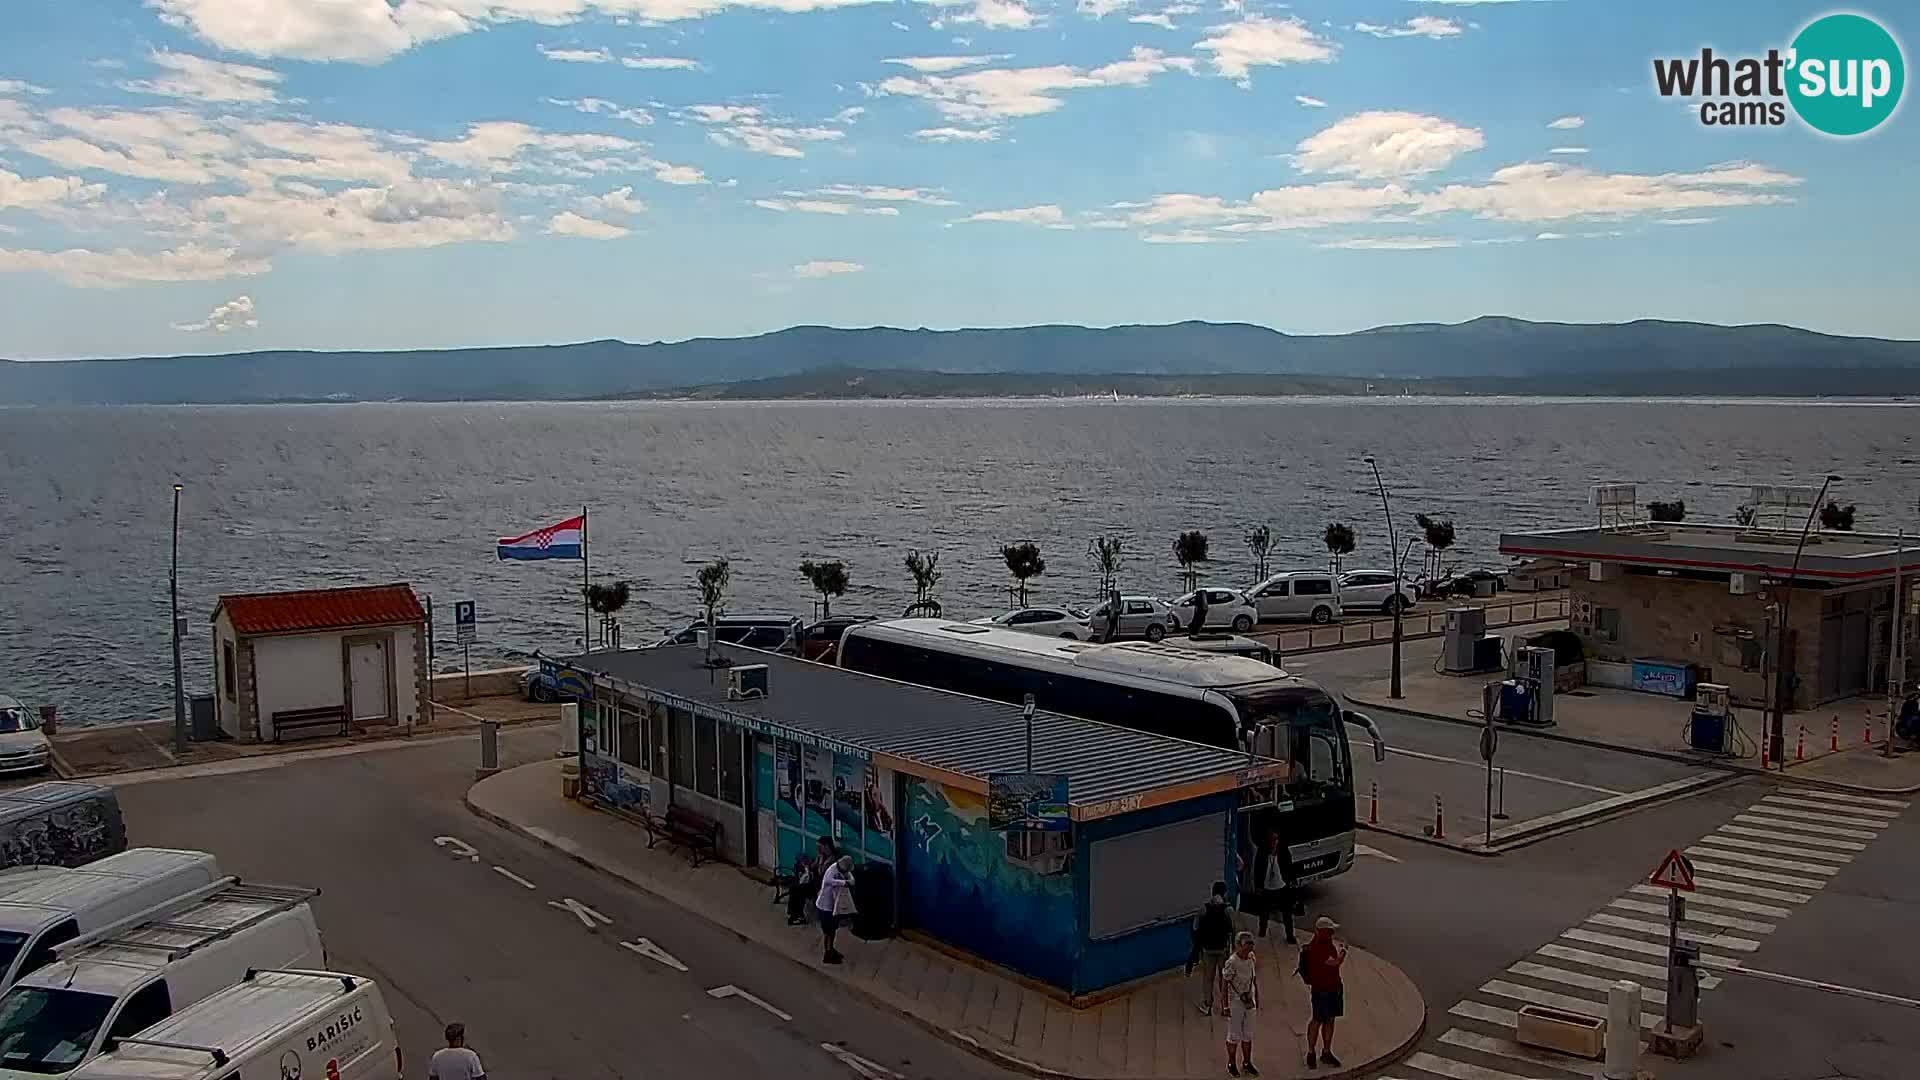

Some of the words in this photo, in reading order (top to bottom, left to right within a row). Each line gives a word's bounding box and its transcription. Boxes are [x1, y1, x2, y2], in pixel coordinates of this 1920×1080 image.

[460, 604, 471, 622] P
[770, 727, 785, 738] BUS
[785, 729, 816, 746] STATION
[818, 739, 842, 753] TICKET
[843, 745, 870, 761] OFFICE
[306, 1005, 363, 1052] BARIŠIĆ
